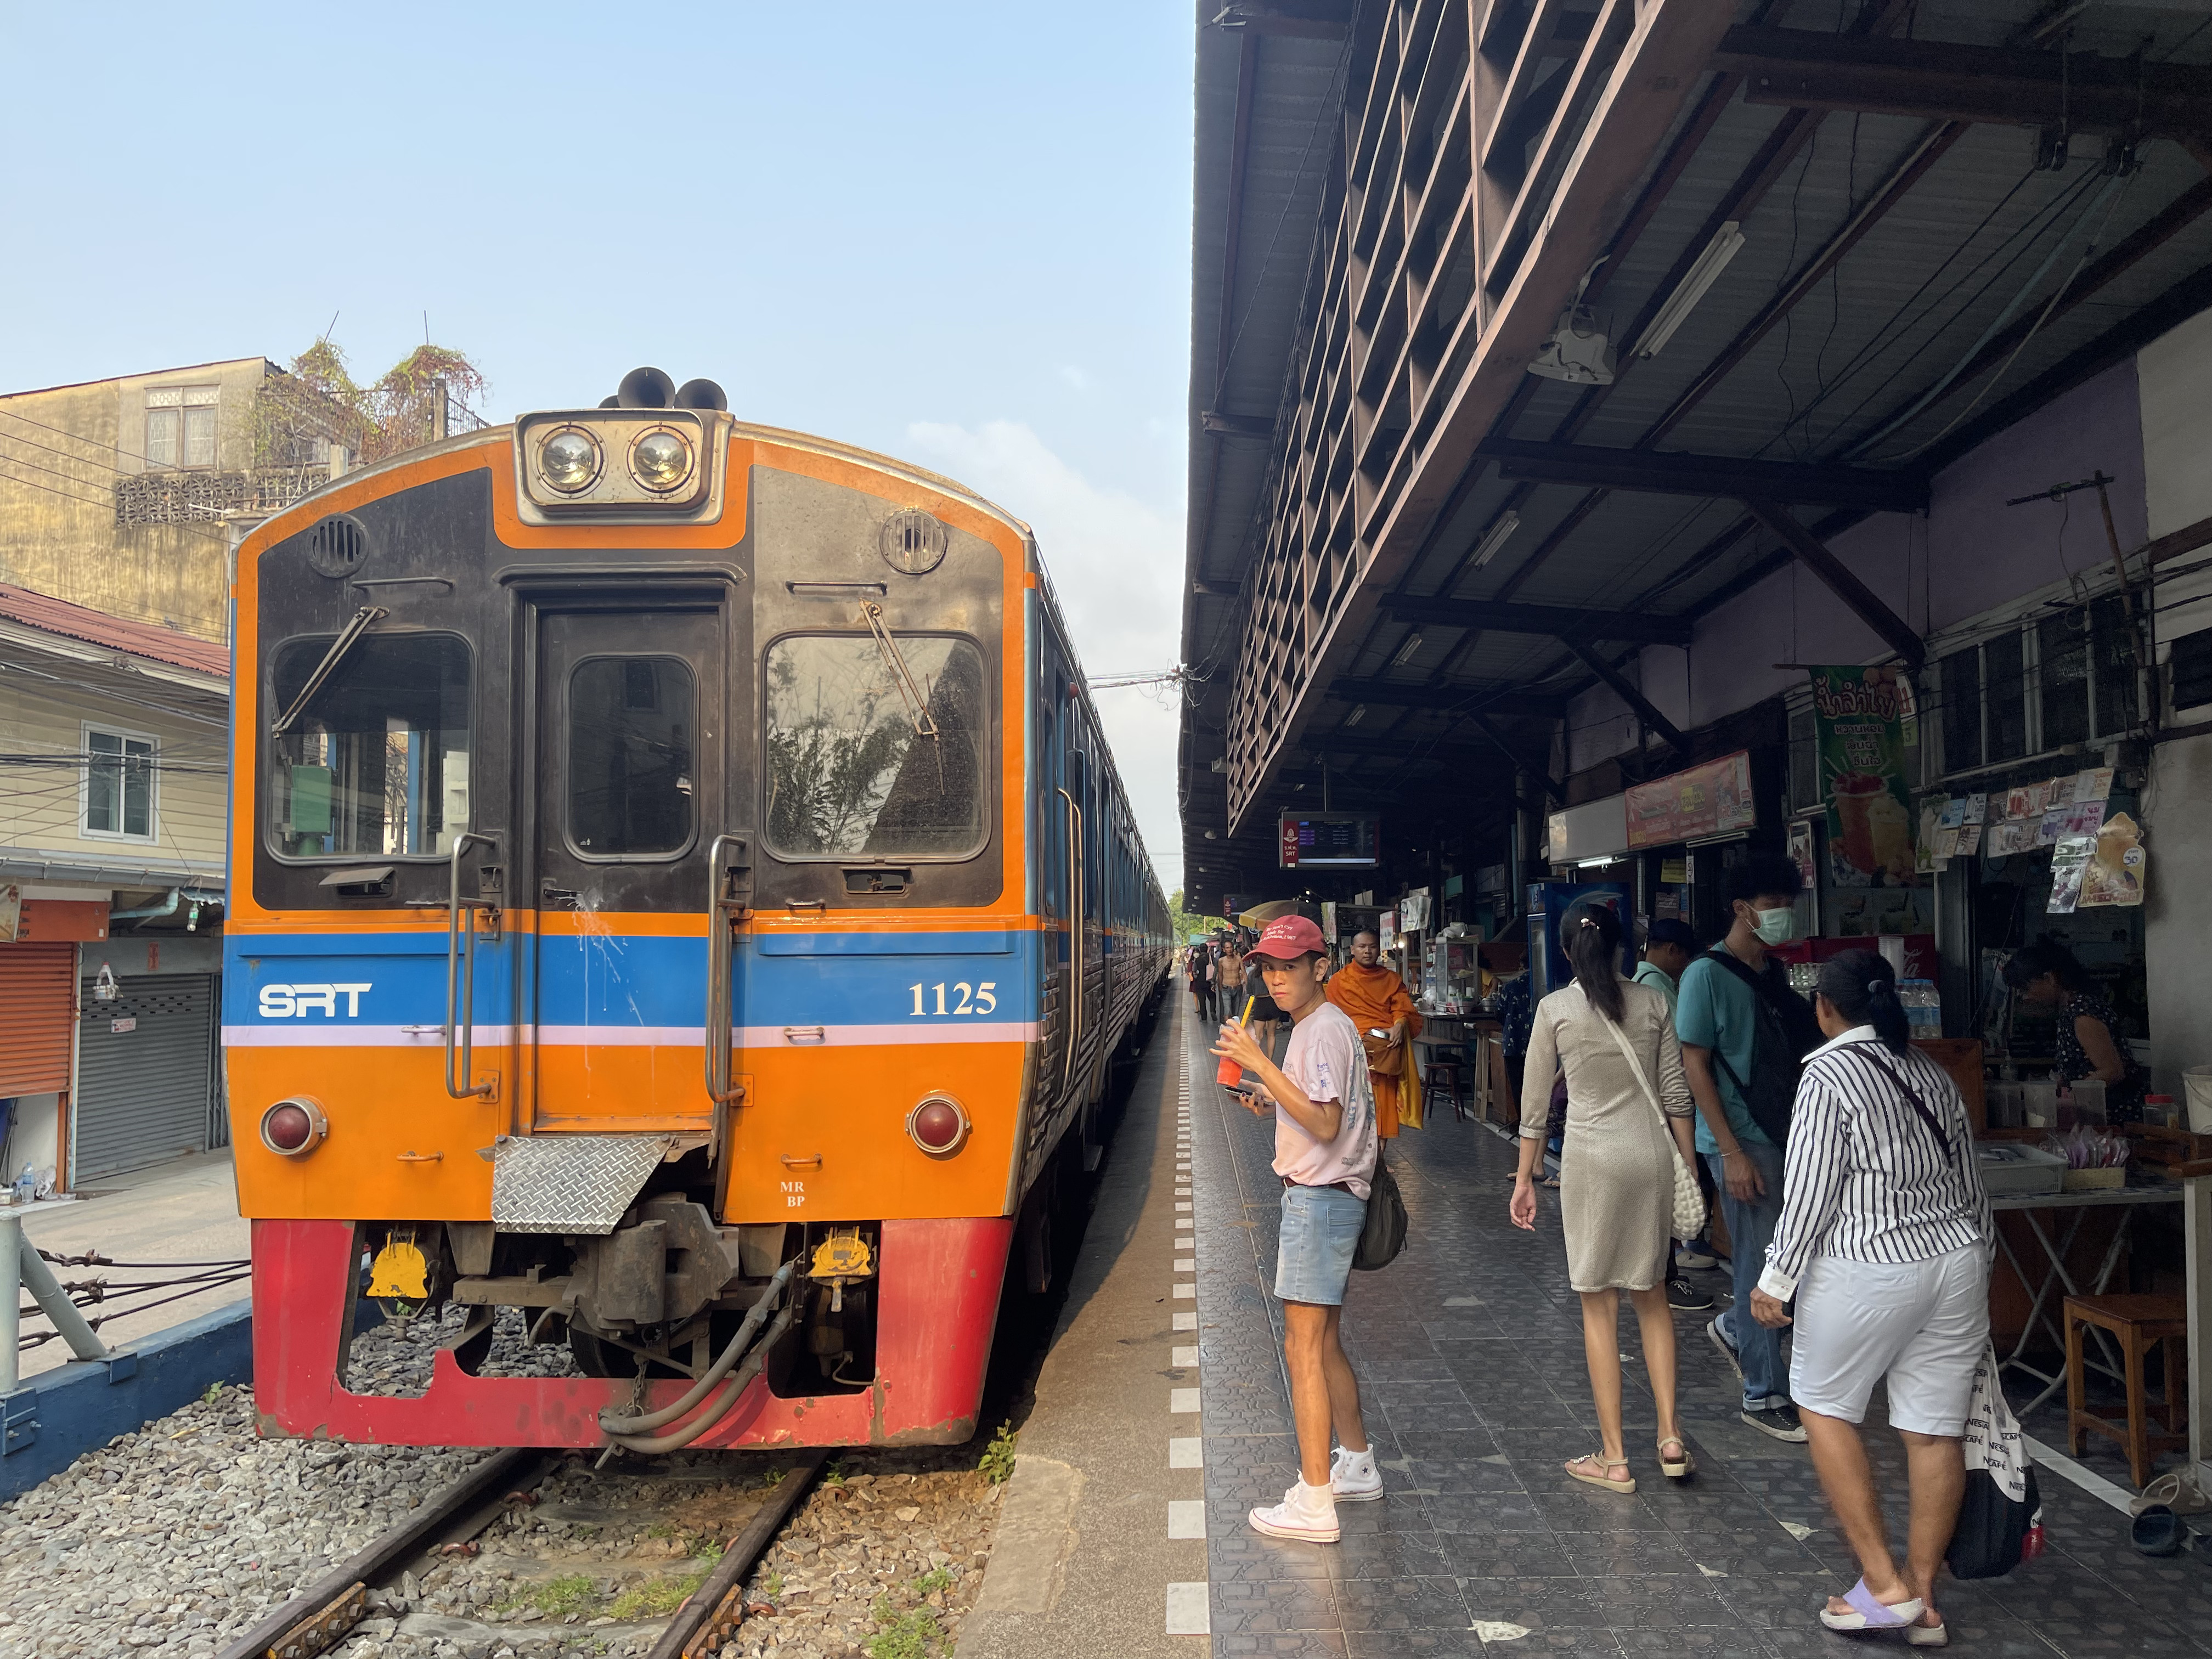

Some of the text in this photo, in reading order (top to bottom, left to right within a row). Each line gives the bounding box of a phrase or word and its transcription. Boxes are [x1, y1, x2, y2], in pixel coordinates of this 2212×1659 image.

[1815, 674, 1897, 721] น้ำลำไย
[1835, 725, 1885, 733] หวานหอม
[2124, 856, 2138, 865] 30
[259, 983, 373, 1018] SRT
[909, 982, 997, 1015] 1125
[780, 1181, 805, 1193] MR
[787, 1195, 805, 1207] BP
